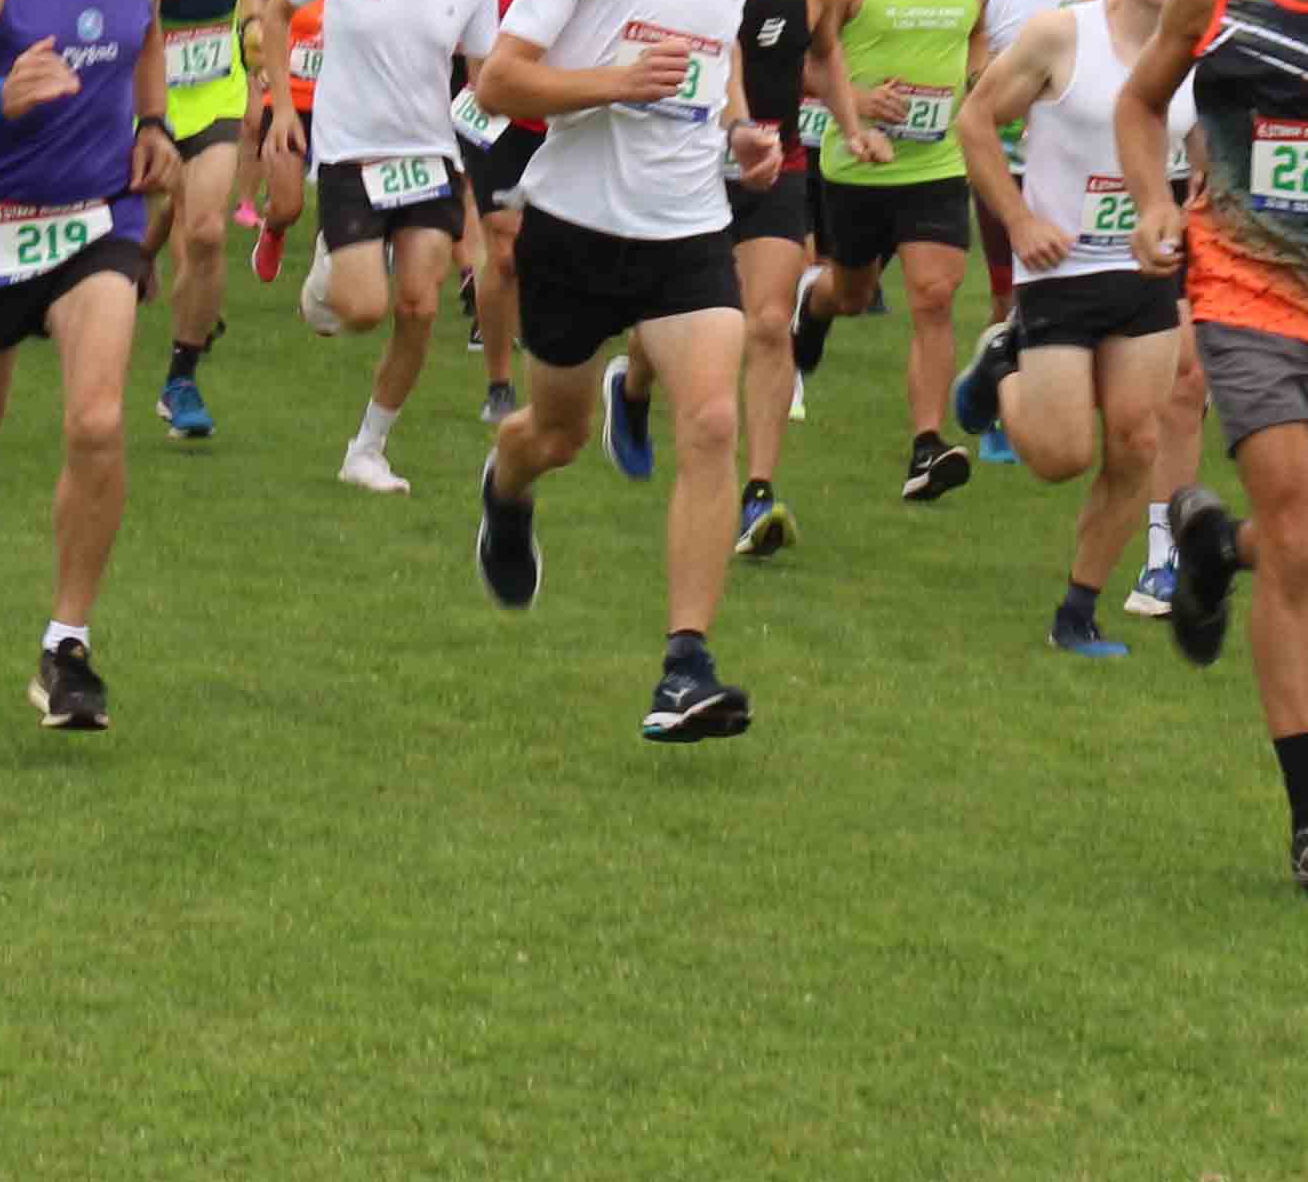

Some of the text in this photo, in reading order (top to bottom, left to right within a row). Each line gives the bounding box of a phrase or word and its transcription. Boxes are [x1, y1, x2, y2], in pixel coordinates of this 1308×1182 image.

[911, 100, 940, 129] 21
[380, 157, 430, 195] 216
[1095, 195, 1137, 231] 22
[18, 218, 88, 265] 219
